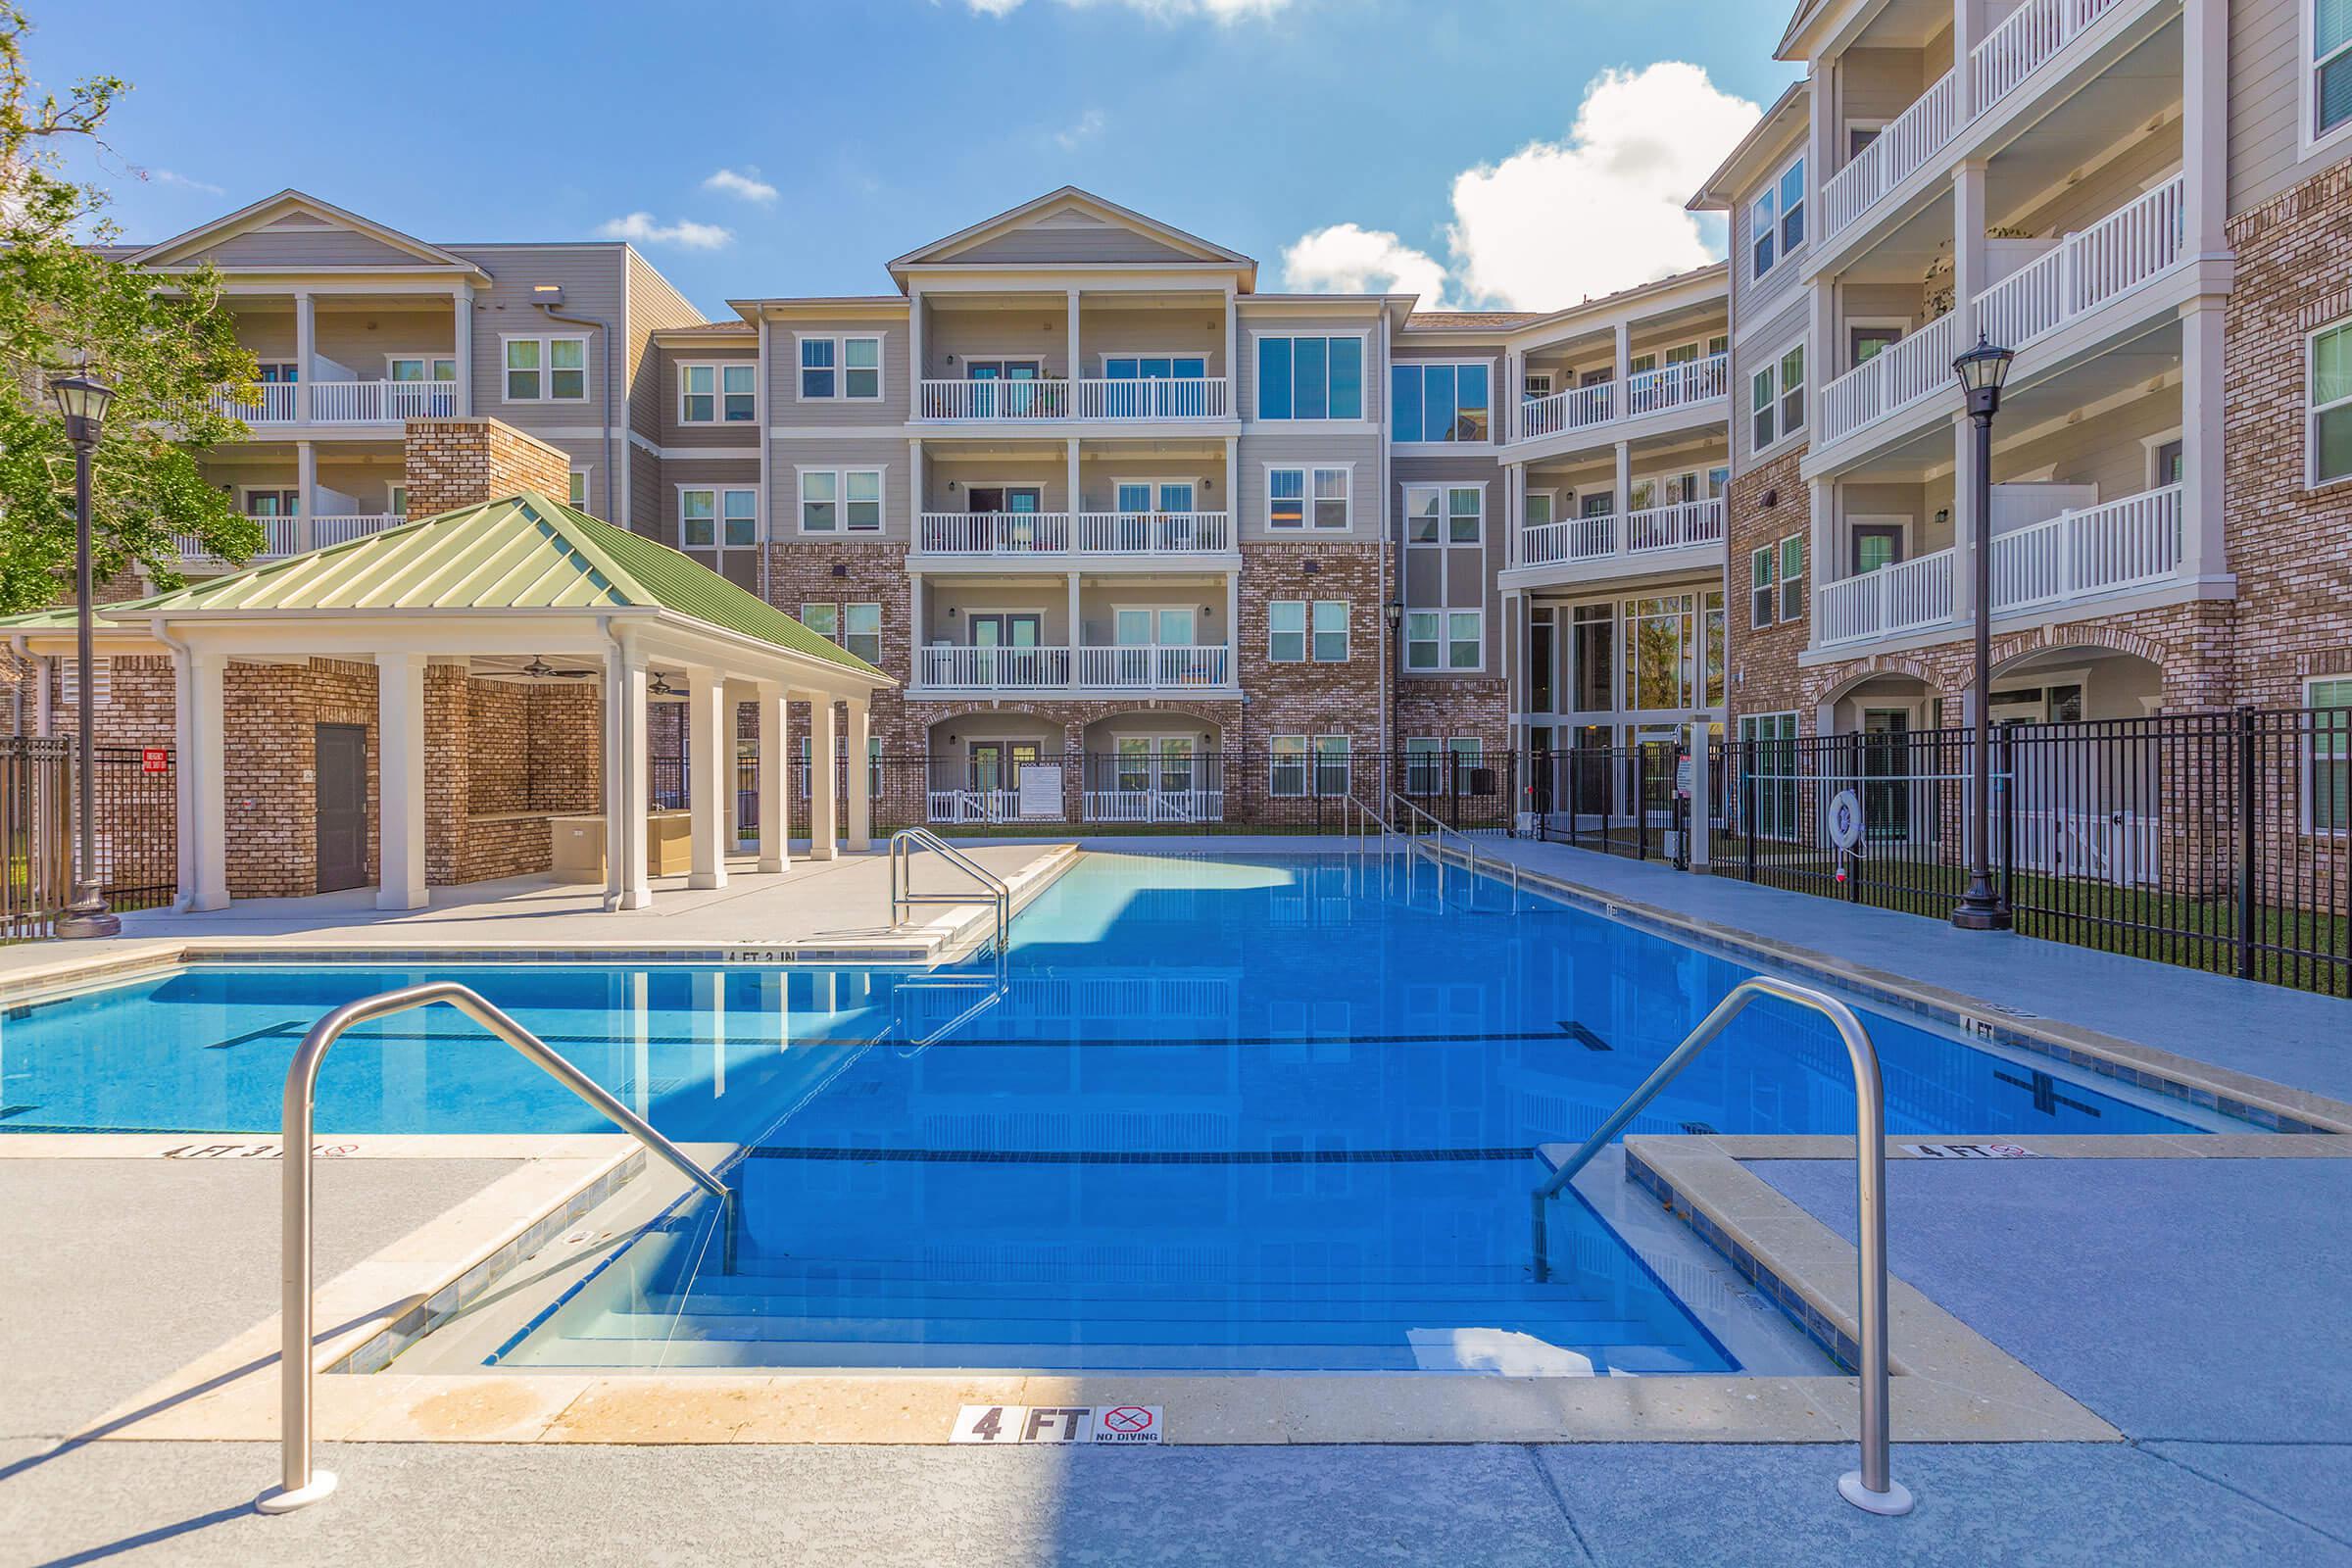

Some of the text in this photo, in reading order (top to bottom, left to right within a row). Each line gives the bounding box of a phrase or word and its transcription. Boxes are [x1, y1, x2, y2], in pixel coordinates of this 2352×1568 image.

[728, 952, 735, 961] 4
[742, 952, 759, 961] FT
[780, 951, 795, 961] IN
[162, 1145, 194, 1158] 4
[190, 1145, 244, 1157] FT
[1918, 1145, 1992, 1157] 4 FT
[971, 1407, 1090, 1441] 4 FT
[1096, 1433, 1158, 1442] NO DIVING
